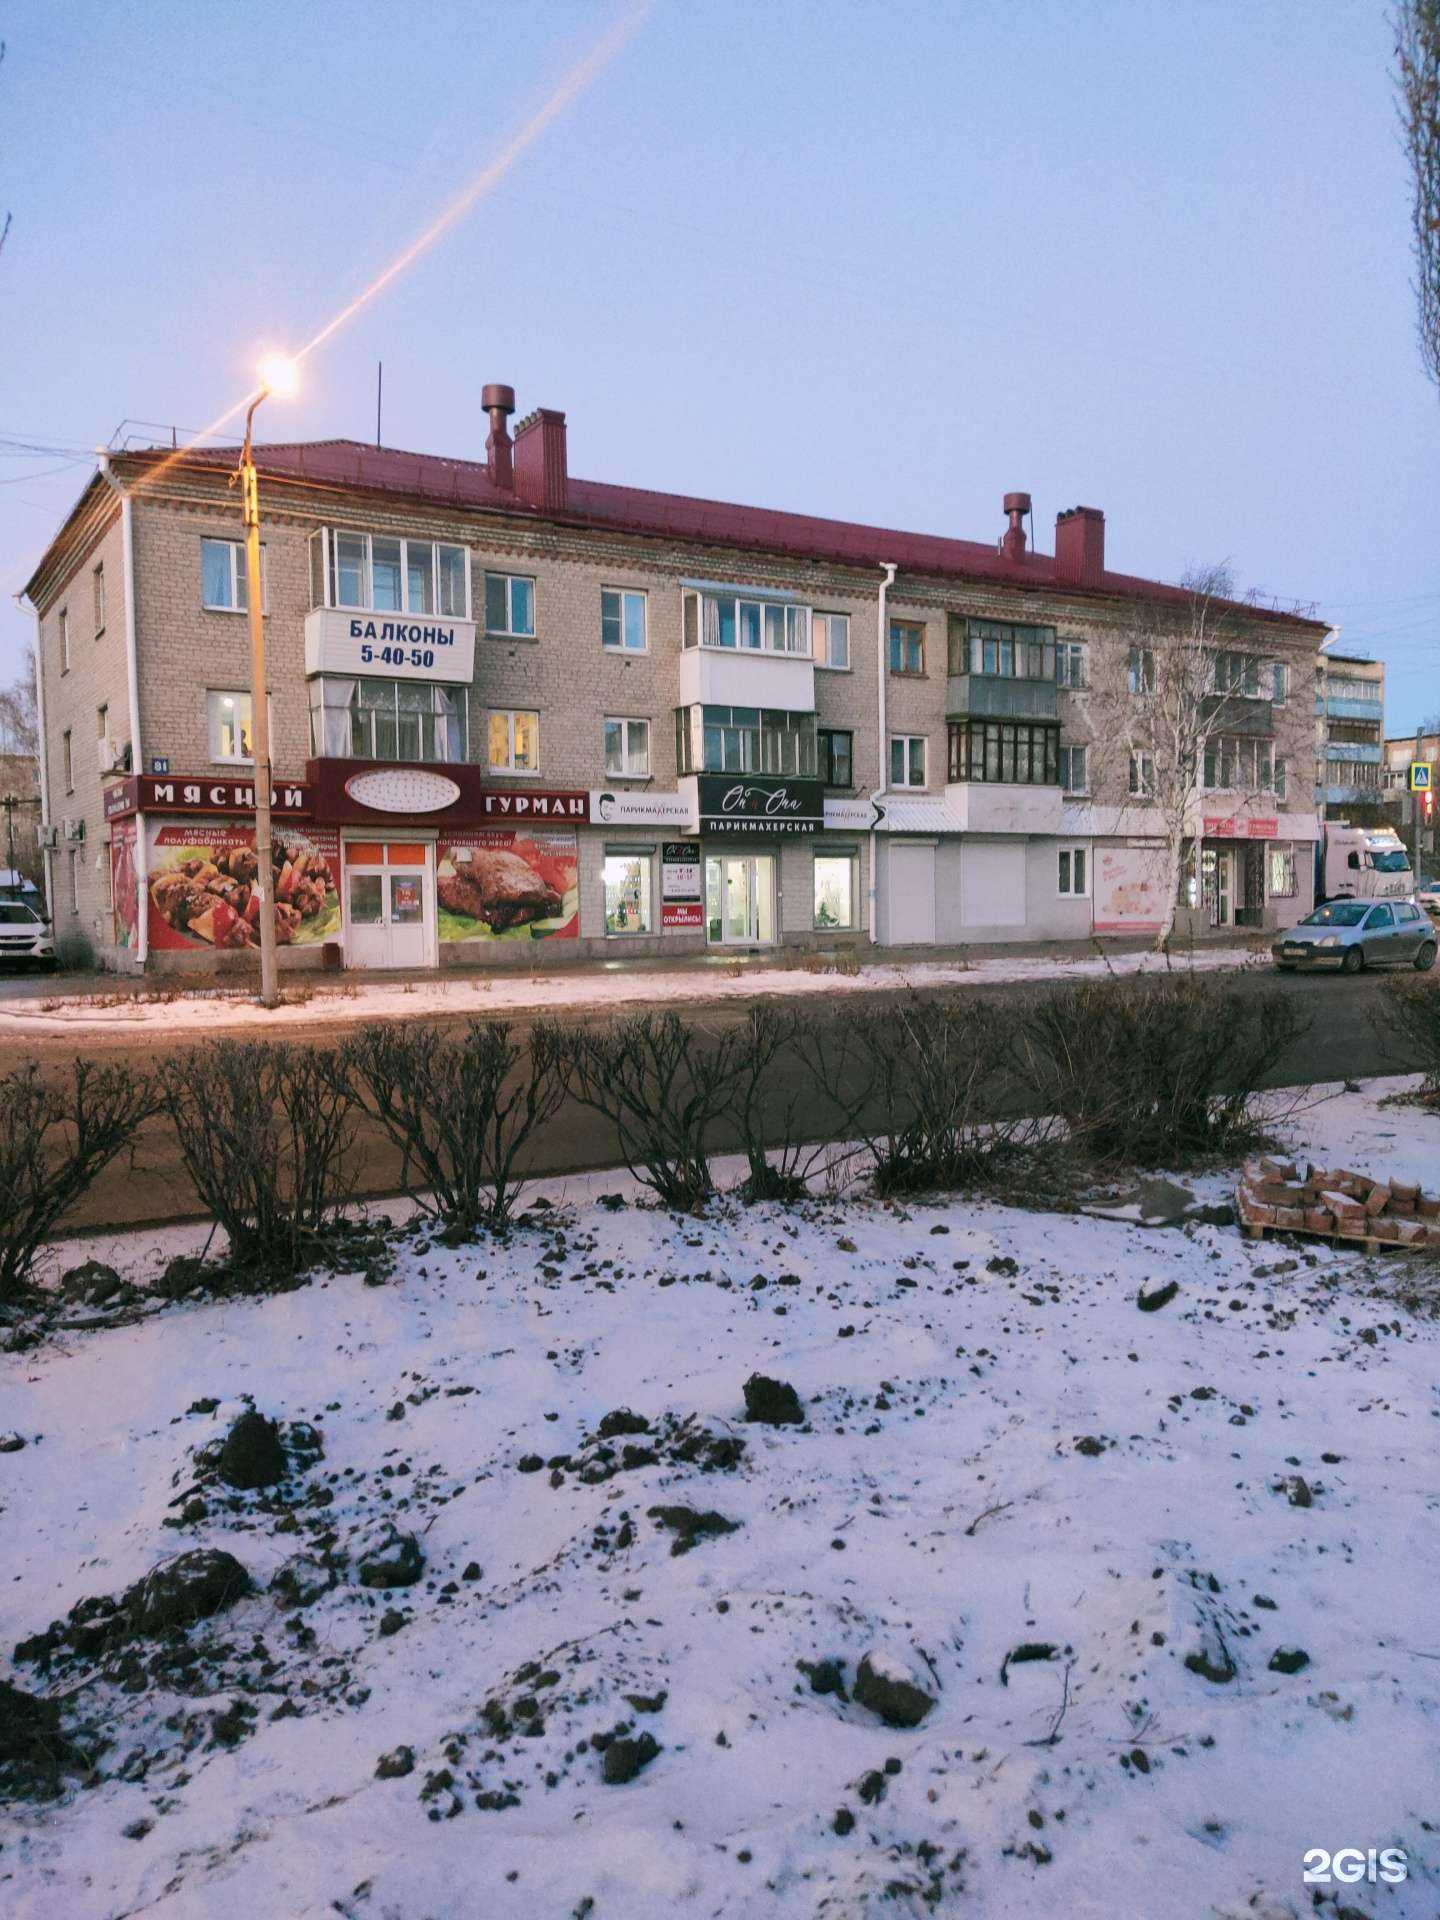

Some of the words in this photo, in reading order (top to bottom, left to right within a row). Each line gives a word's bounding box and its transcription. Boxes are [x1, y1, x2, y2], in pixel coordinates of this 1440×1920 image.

[350, 619, 454, 646] БАЛКОНЫ
[361, 645, 434, 668] 5-40-50
[485, 796, 584, 814] ГУРМАН
[620, 805, 689, 816] ПАРИКМАХЕРСКАЯ
[710, 821, 815, 833] ПАРИКМАХЕРСКАЯ
